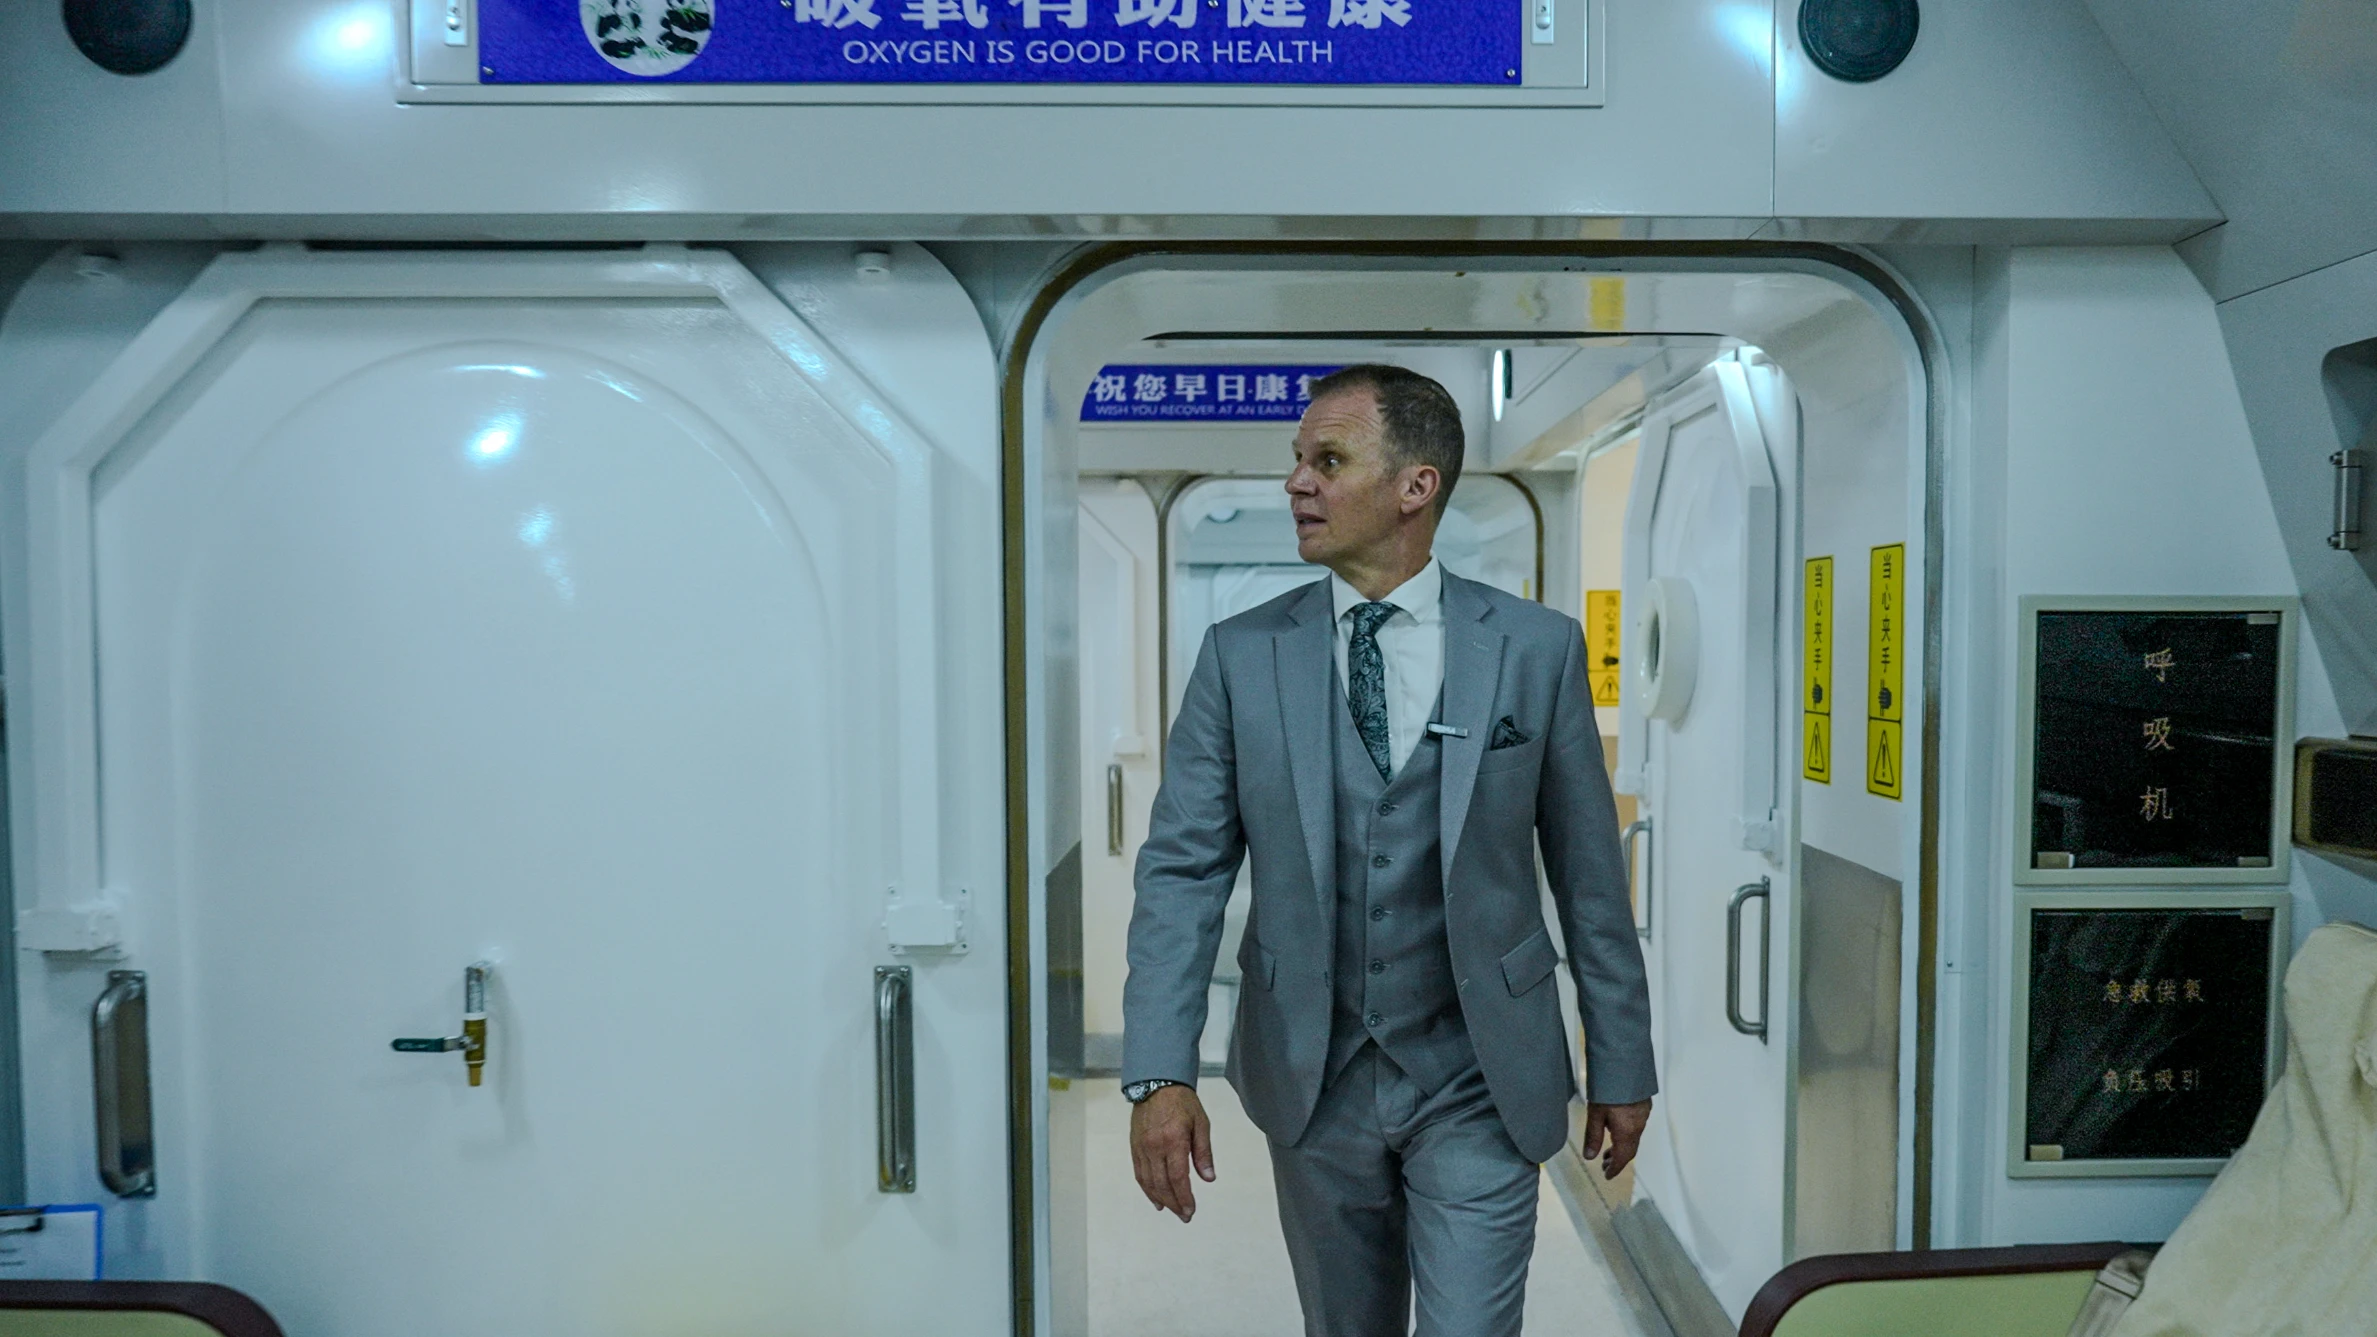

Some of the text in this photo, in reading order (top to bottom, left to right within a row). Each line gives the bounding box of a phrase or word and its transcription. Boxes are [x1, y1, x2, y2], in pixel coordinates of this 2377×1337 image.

[843, 41, 1332, 63] OXYGEN IS GOOD FOR HEALTH
[1096, 405, 1128, 415] WISH
[1132, 405, 1157, 415] YOU
[1160, 405, 1215, 416] RECOVER
[1218, 405, 1232, 415] AT
[1236, 405, 1255, 415] AN
[1258, 405, 1294, 415] EARLY
[1813, 564, 1823, 671] 当心夹手
[1881, 553, 1891, 674] 当心夹手
[2139, 648, 2176, 822] 呼吸机
